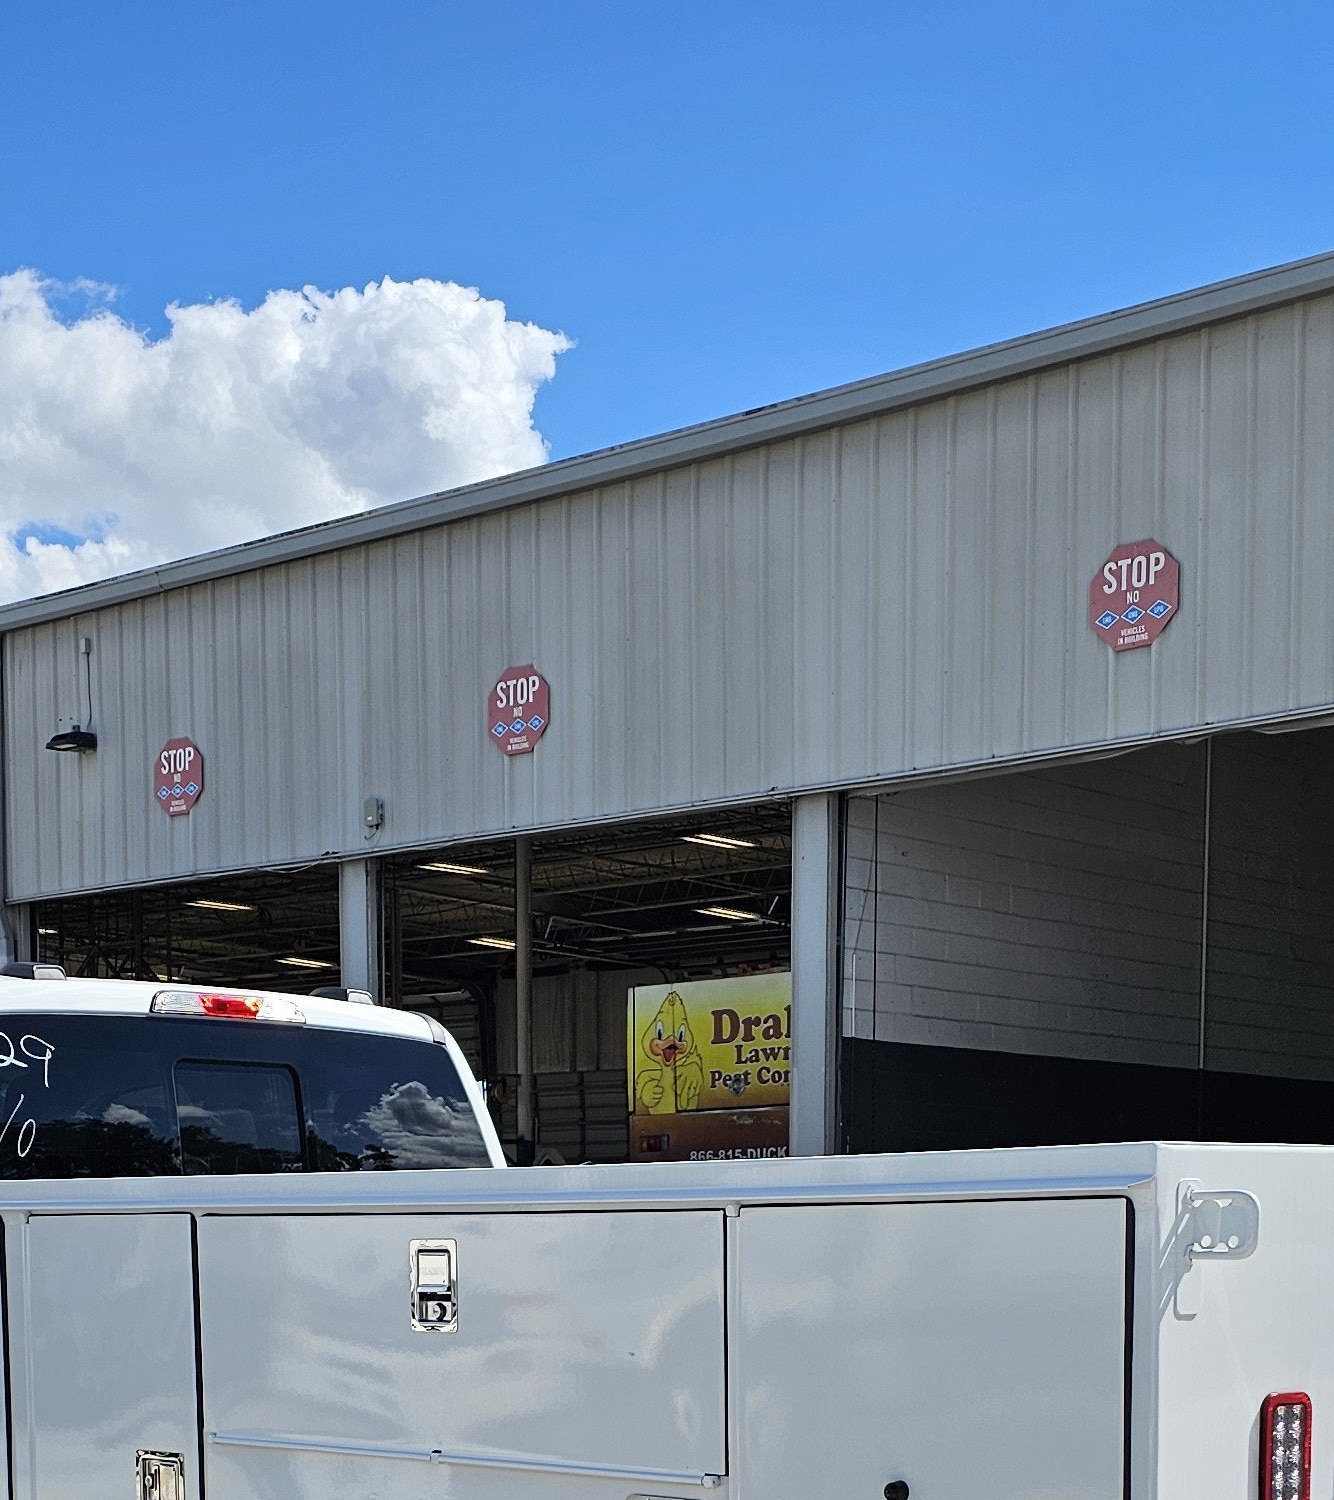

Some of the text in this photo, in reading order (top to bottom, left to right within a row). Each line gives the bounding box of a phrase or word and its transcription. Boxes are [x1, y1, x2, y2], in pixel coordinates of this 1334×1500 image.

[1103, 552, 1165, 594] STOP
[1127, 591, 1139, 604] NO
[496, 676, 539, 708] STOP
[161, 747, 194, 774] STOP
[710, 1069, 752, 1089] Pet
